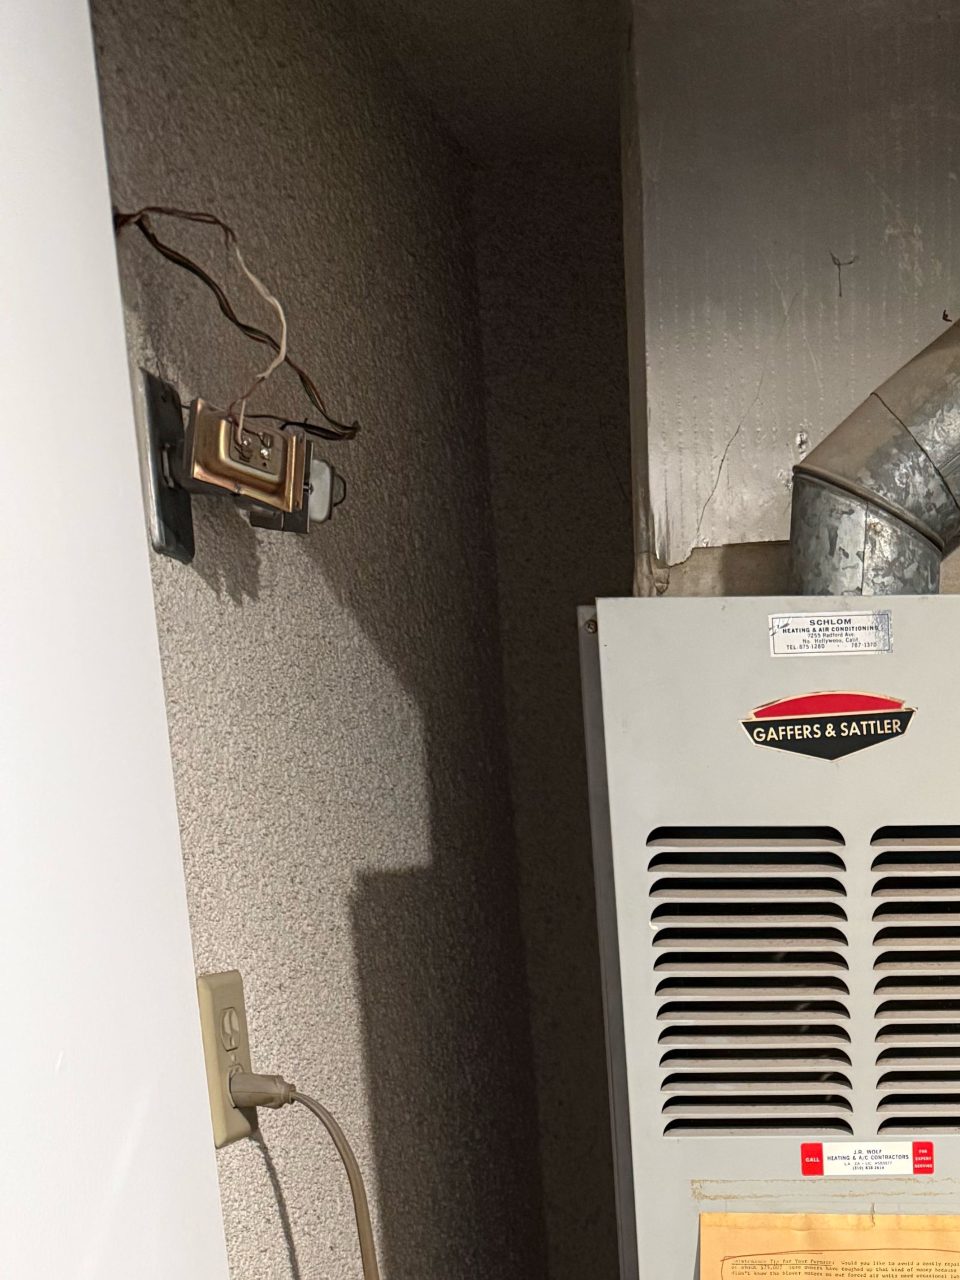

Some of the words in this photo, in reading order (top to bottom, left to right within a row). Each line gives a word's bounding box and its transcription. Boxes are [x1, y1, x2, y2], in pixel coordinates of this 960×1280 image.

[753, 724, 821, 742] GAFFERS
[825, 724, 836, 737] &
[840, 719, 901, 736] SATTLER
